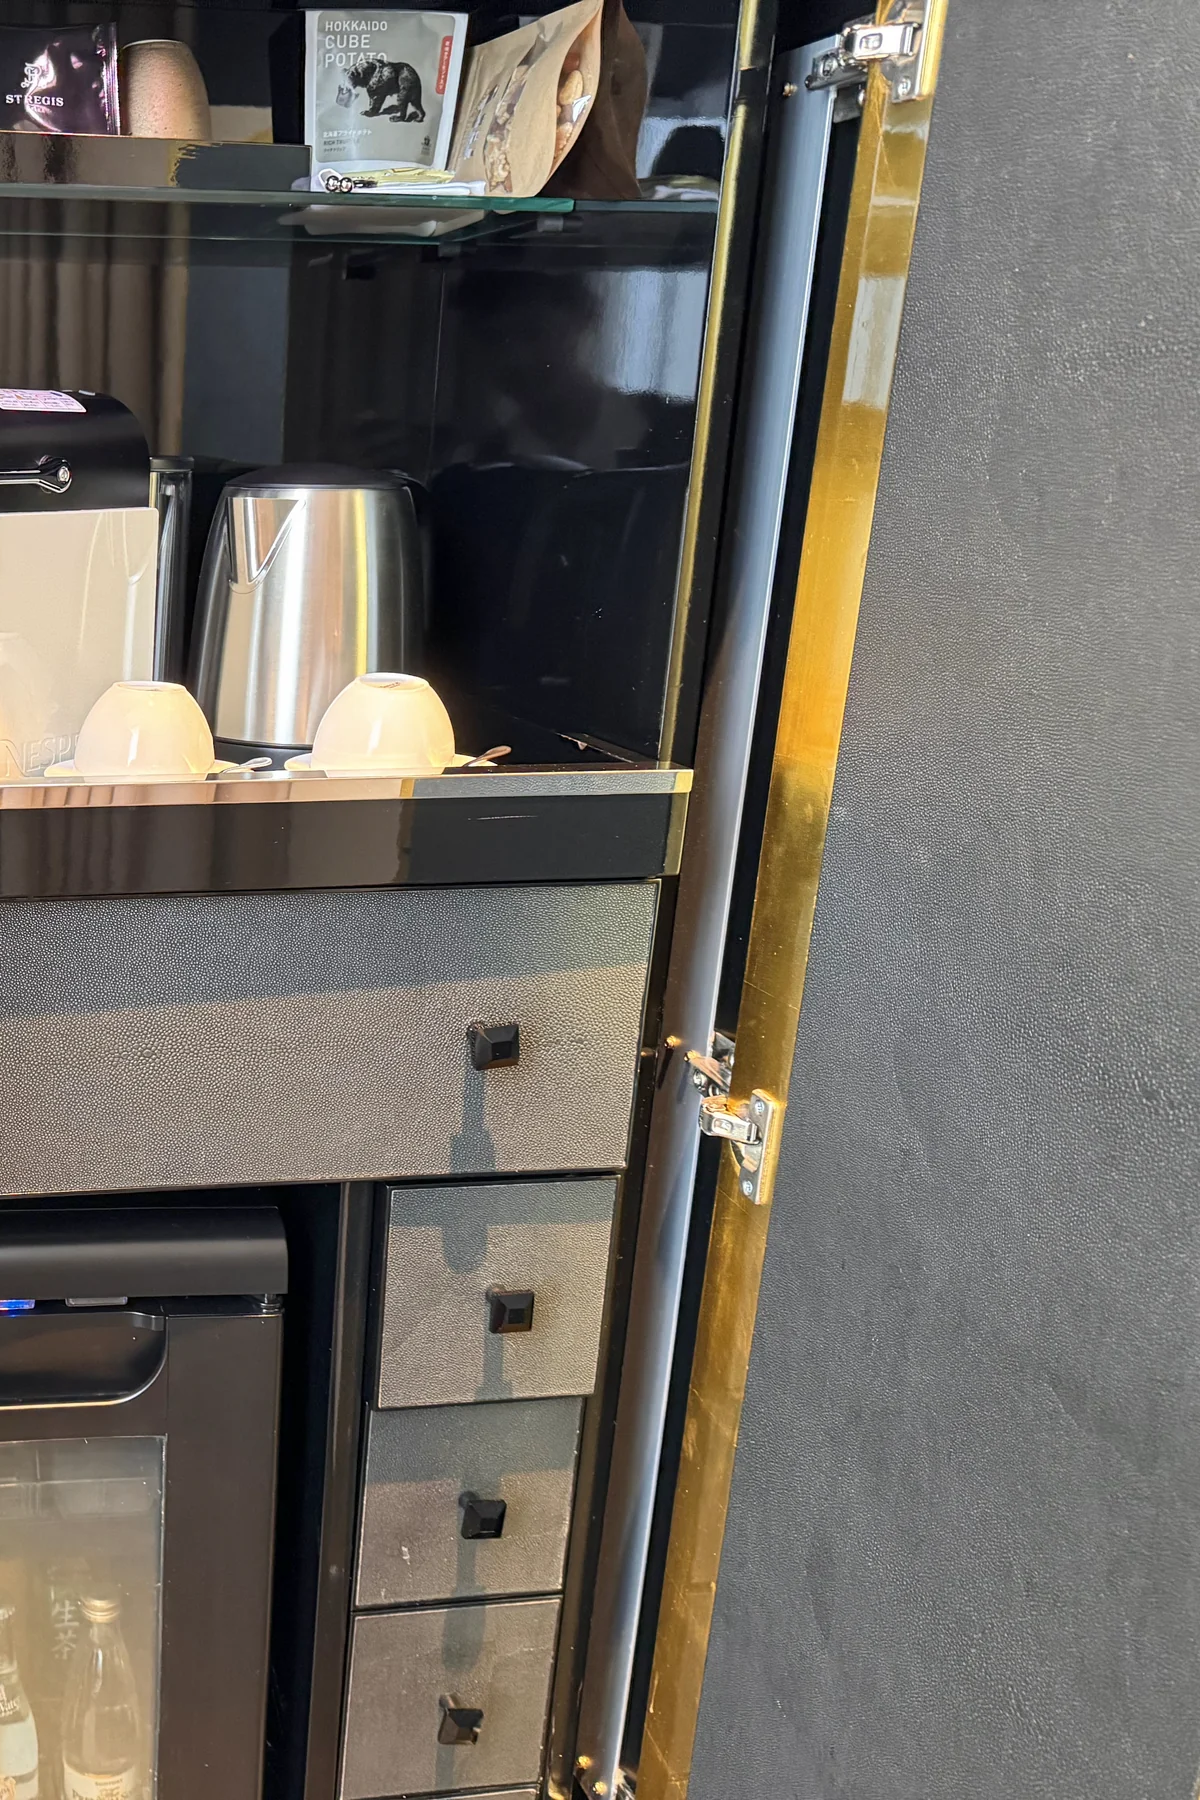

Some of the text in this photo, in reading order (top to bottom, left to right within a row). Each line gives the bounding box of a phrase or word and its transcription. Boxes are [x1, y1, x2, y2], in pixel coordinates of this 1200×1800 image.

[325, 20, 388, 32] HOKKAIDO
[325, 34, 371, 49] CUBE
[325, 52, 388, 68] POTATO
[24, 95, 64, 107] REGIS
